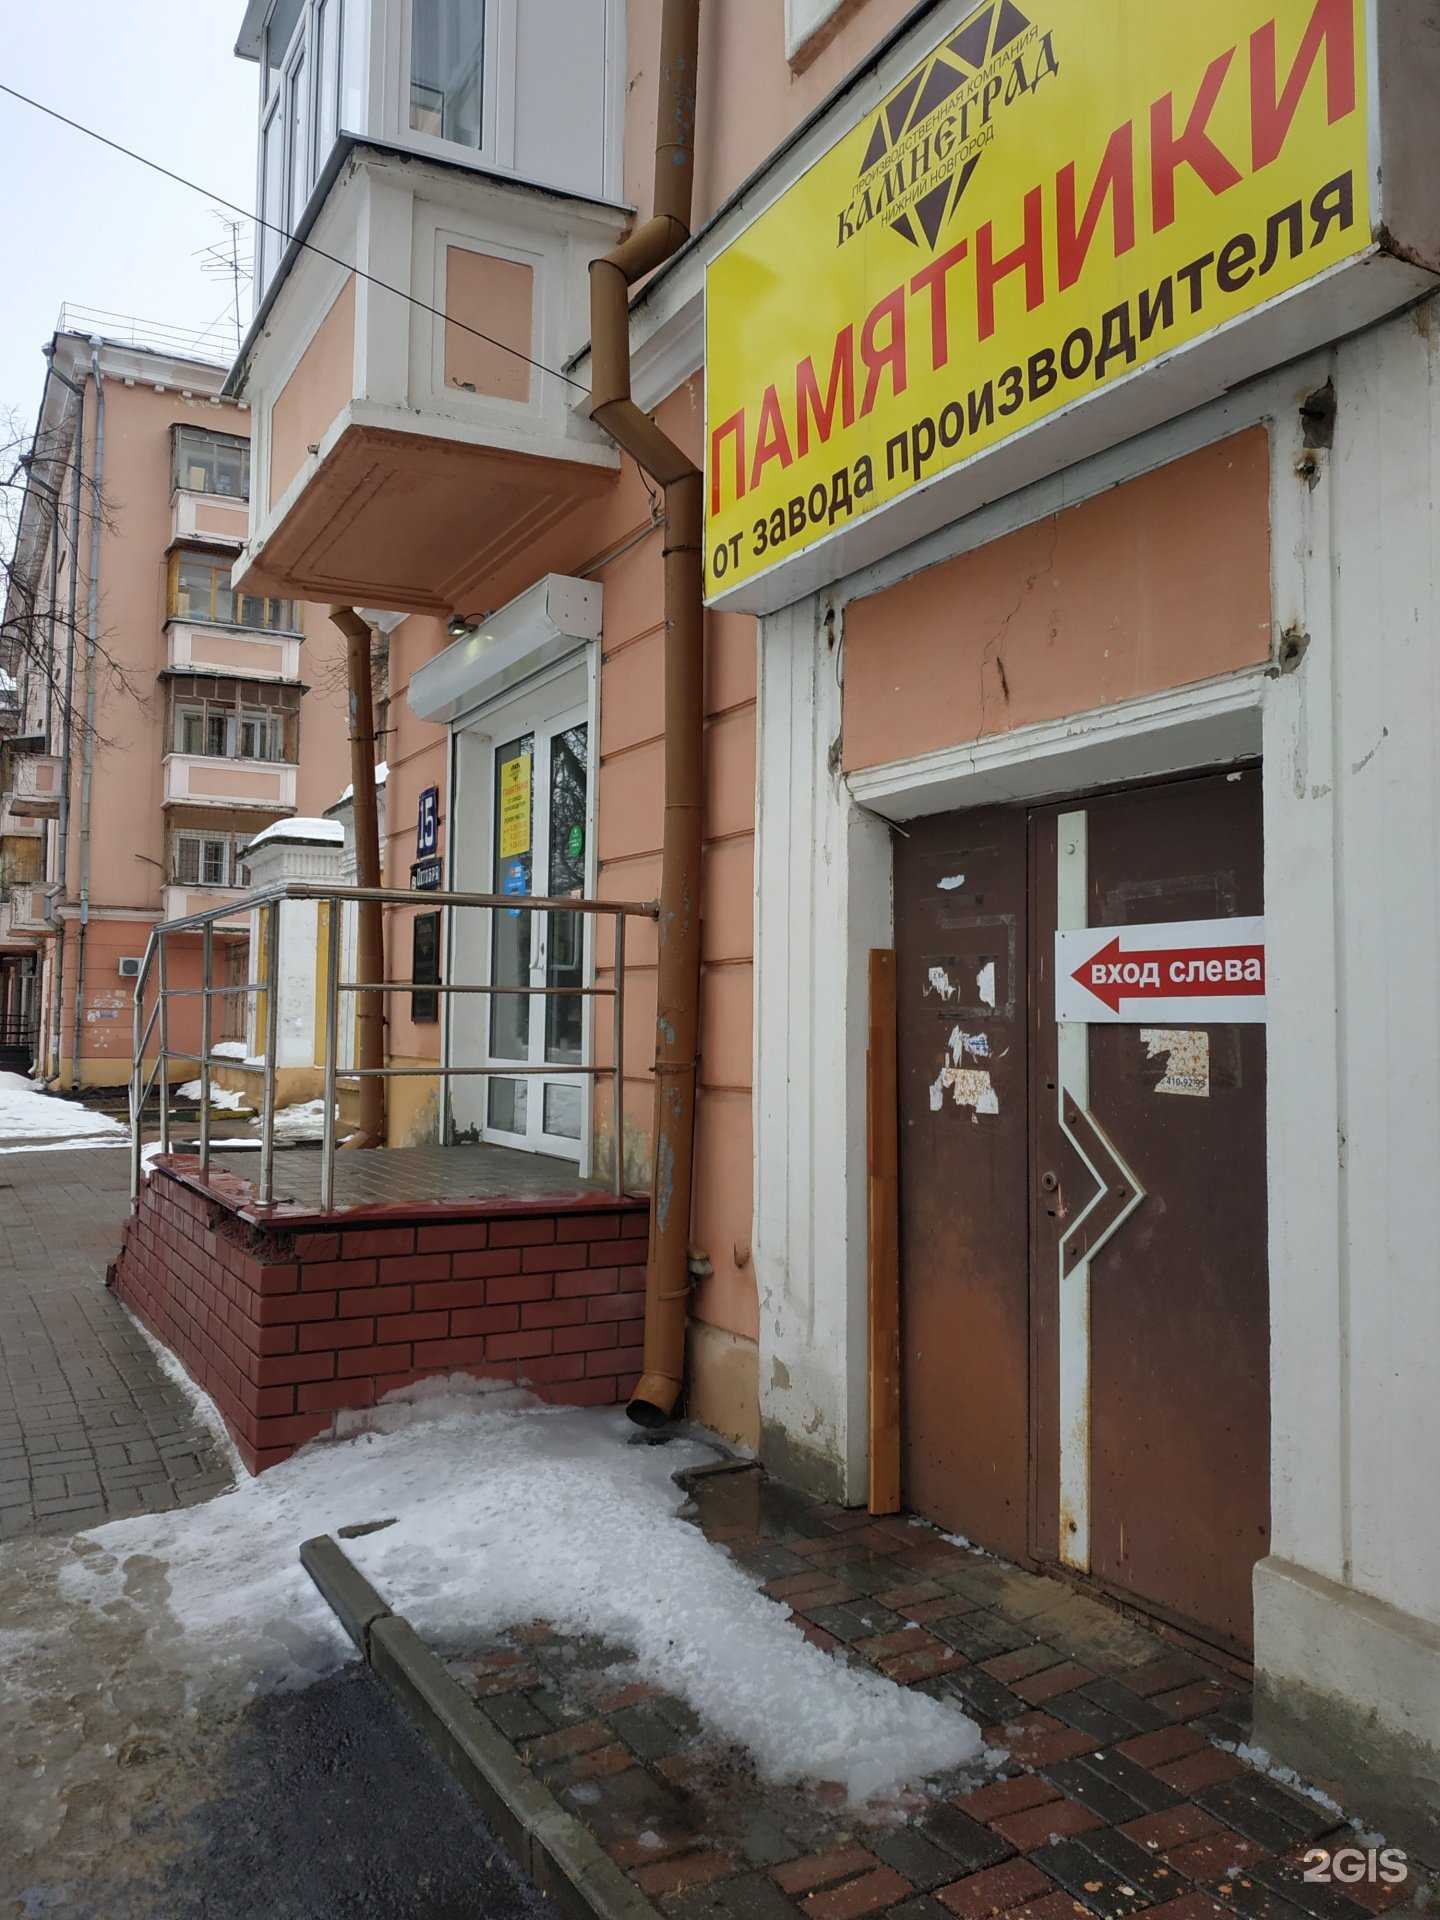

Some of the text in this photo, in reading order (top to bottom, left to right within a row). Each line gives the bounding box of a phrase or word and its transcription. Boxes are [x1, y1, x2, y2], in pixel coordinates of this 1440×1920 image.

[851, 24, 1040, 198] ПРОИЗВОДСТВЕННАЯ КОМПАНИЯ
[881, 124, 995, 227] НИЖНИЙ НОВГОРОД
[711, 0, 1356, 518] ПАМЯТНИКИ
[713, 168, 1354, 579] от завода производителя
[418, 796, 434, 849] 15
[1091, 957, 1262, 988] вход слева
